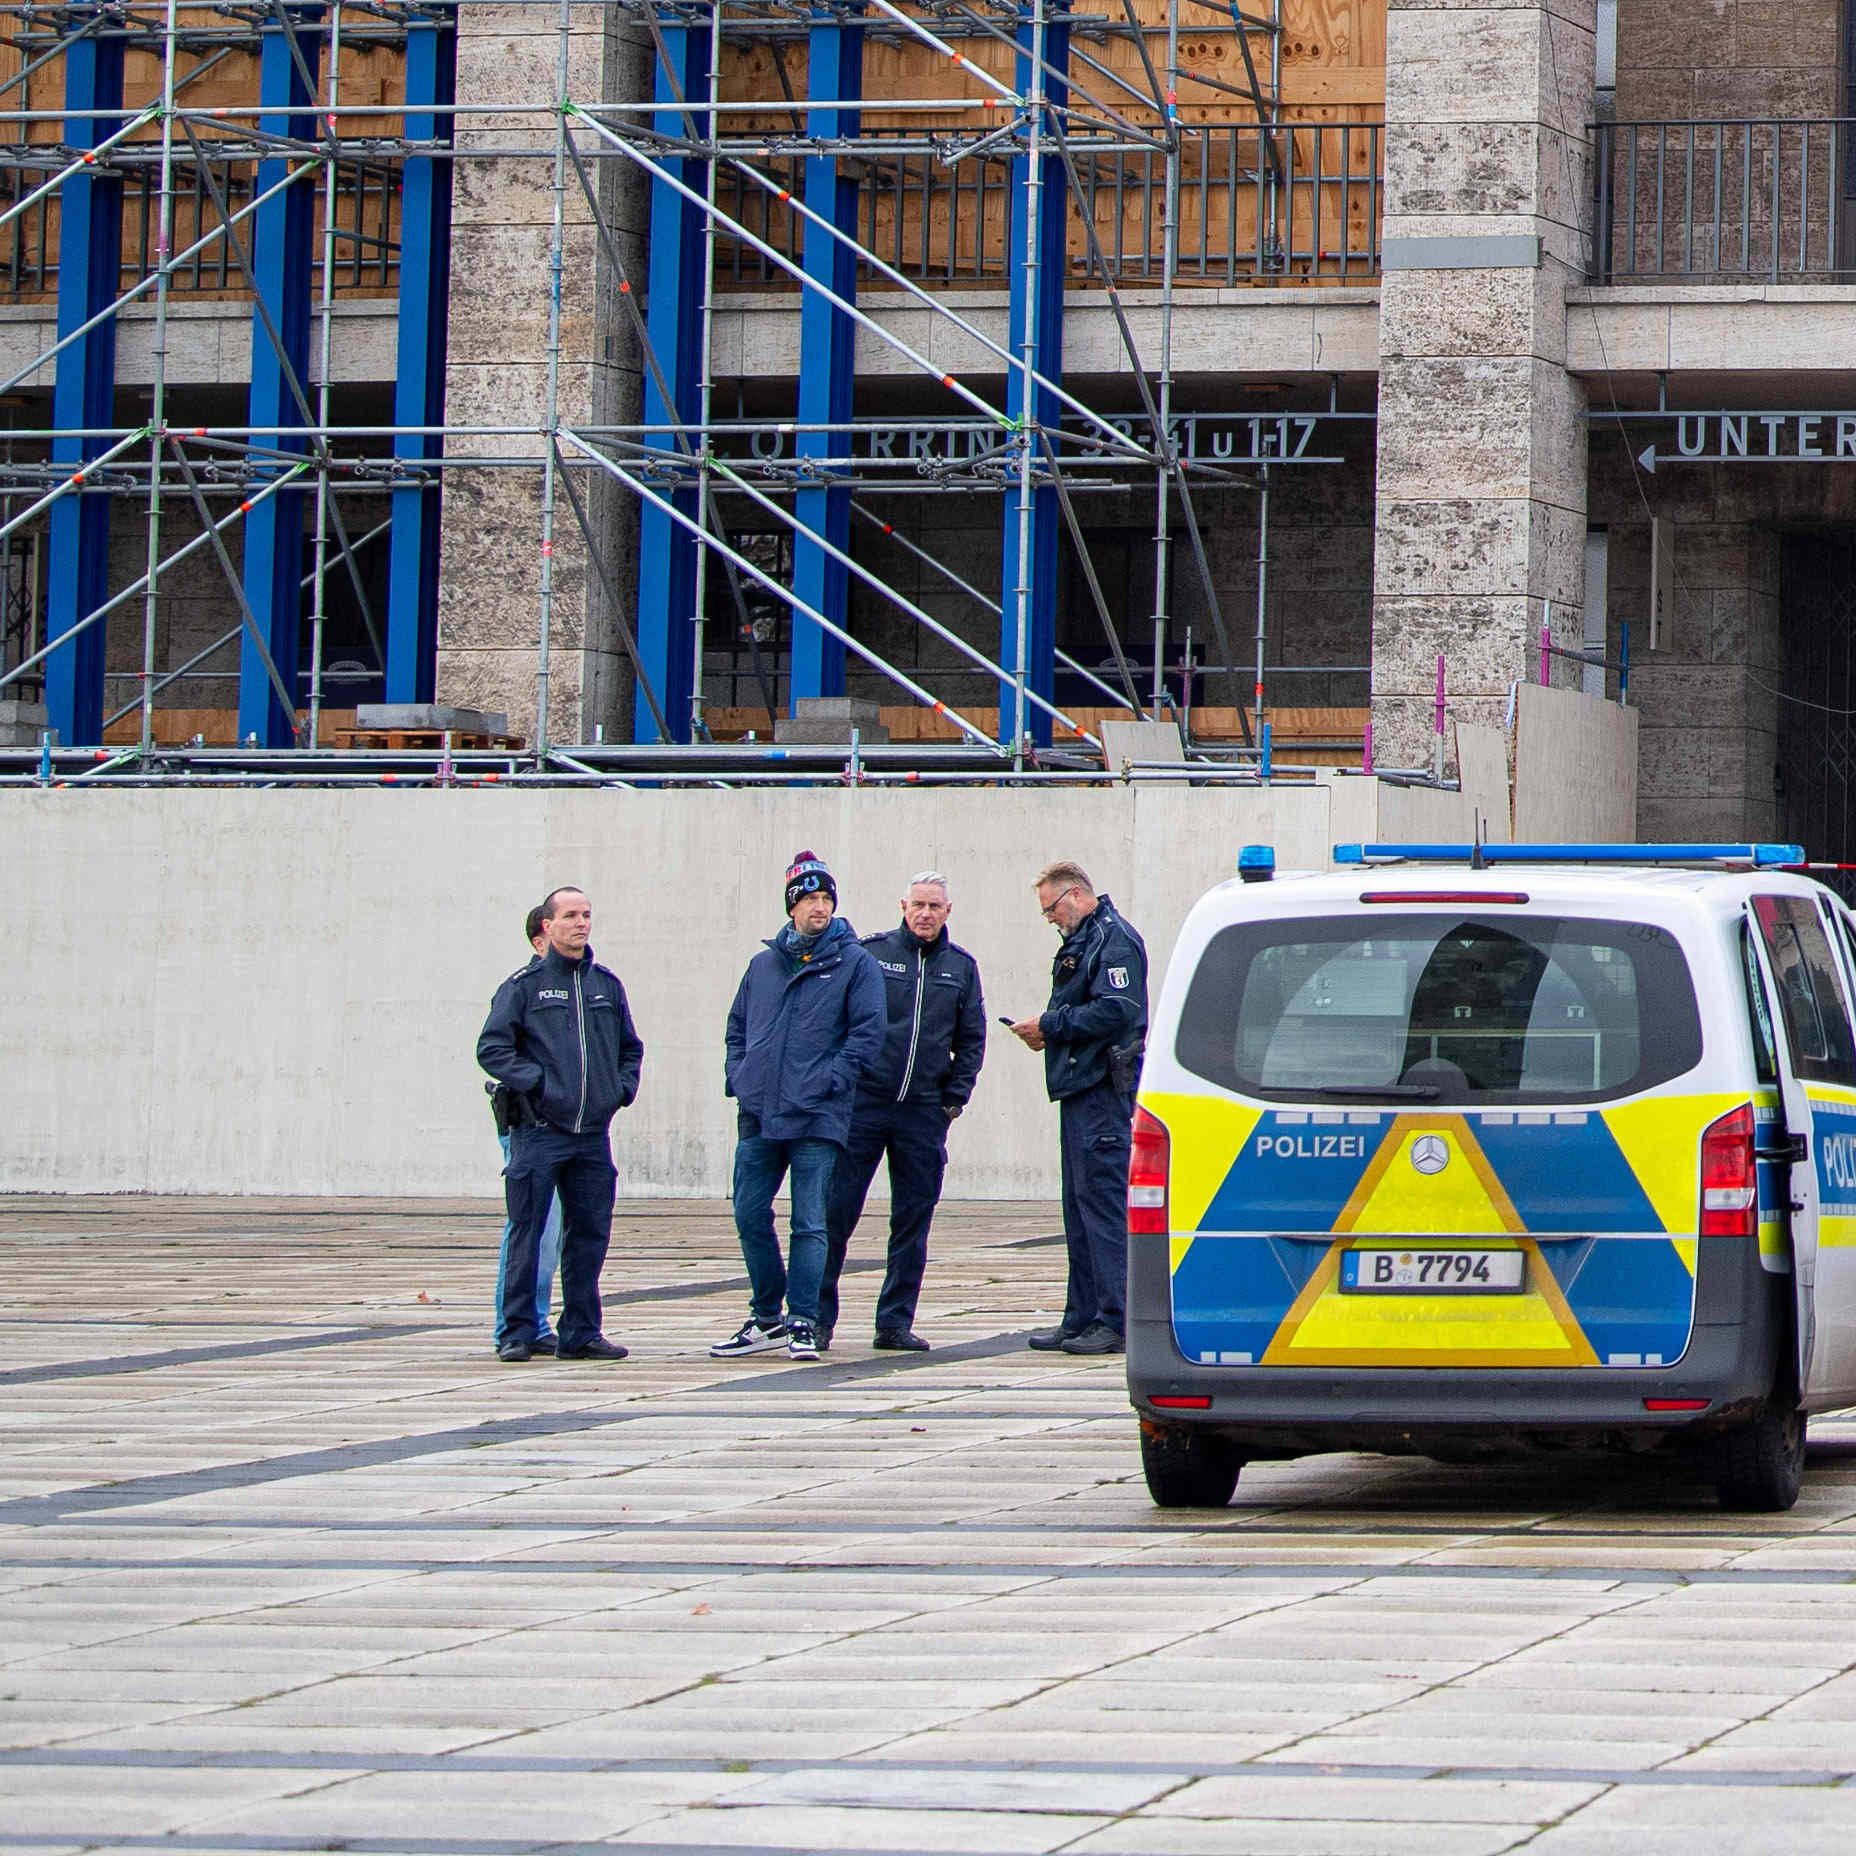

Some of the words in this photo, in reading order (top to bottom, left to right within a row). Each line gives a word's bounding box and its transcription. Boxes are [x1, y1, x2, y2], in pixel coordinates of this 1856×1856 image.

[1247, 418, 1317, 459] 1-17
[1257, 1135, 1365, 1157] POLIZEI
[1374, 1255, 1393, 1283] B
[1417, 1254, 1490, 1283] 7794
